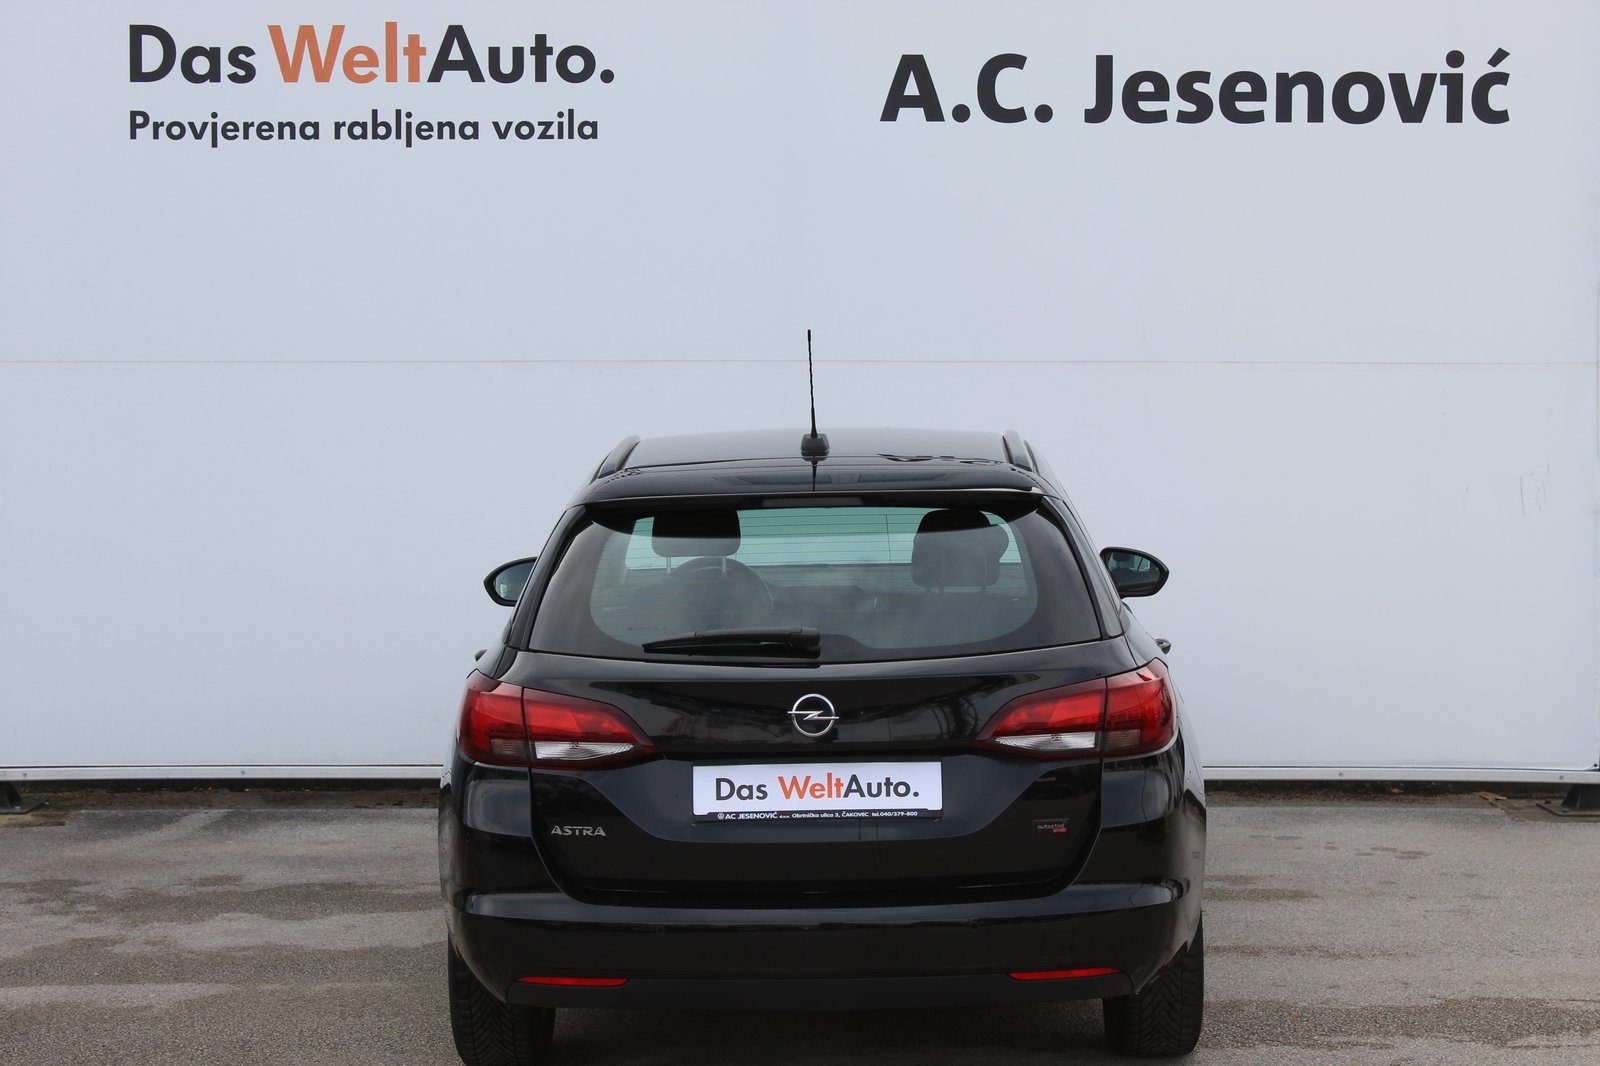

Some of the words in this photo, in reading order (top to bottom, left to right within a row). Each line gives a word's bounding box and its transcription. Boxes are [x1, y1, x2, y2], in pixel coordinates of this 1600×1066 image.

[130, 24, 256, 84] Das
[268, 22, 615, 84] WeltAuto.
[880, 53, 1054, 124] A.C.
[1084, 47, 1511, 125] Jesenović
[129, 110, 320, 148] Provjerena
[334, 109, 479, 148] rabljena
[492, 109, 599, 141] vozila
[715, 777, 768, 801] Das
[777, 772, 920, 800] WeltAuto.
[551, 825, 606, 836] ASTRA
[738, 811, 778, 820] JESENOVIĆ
